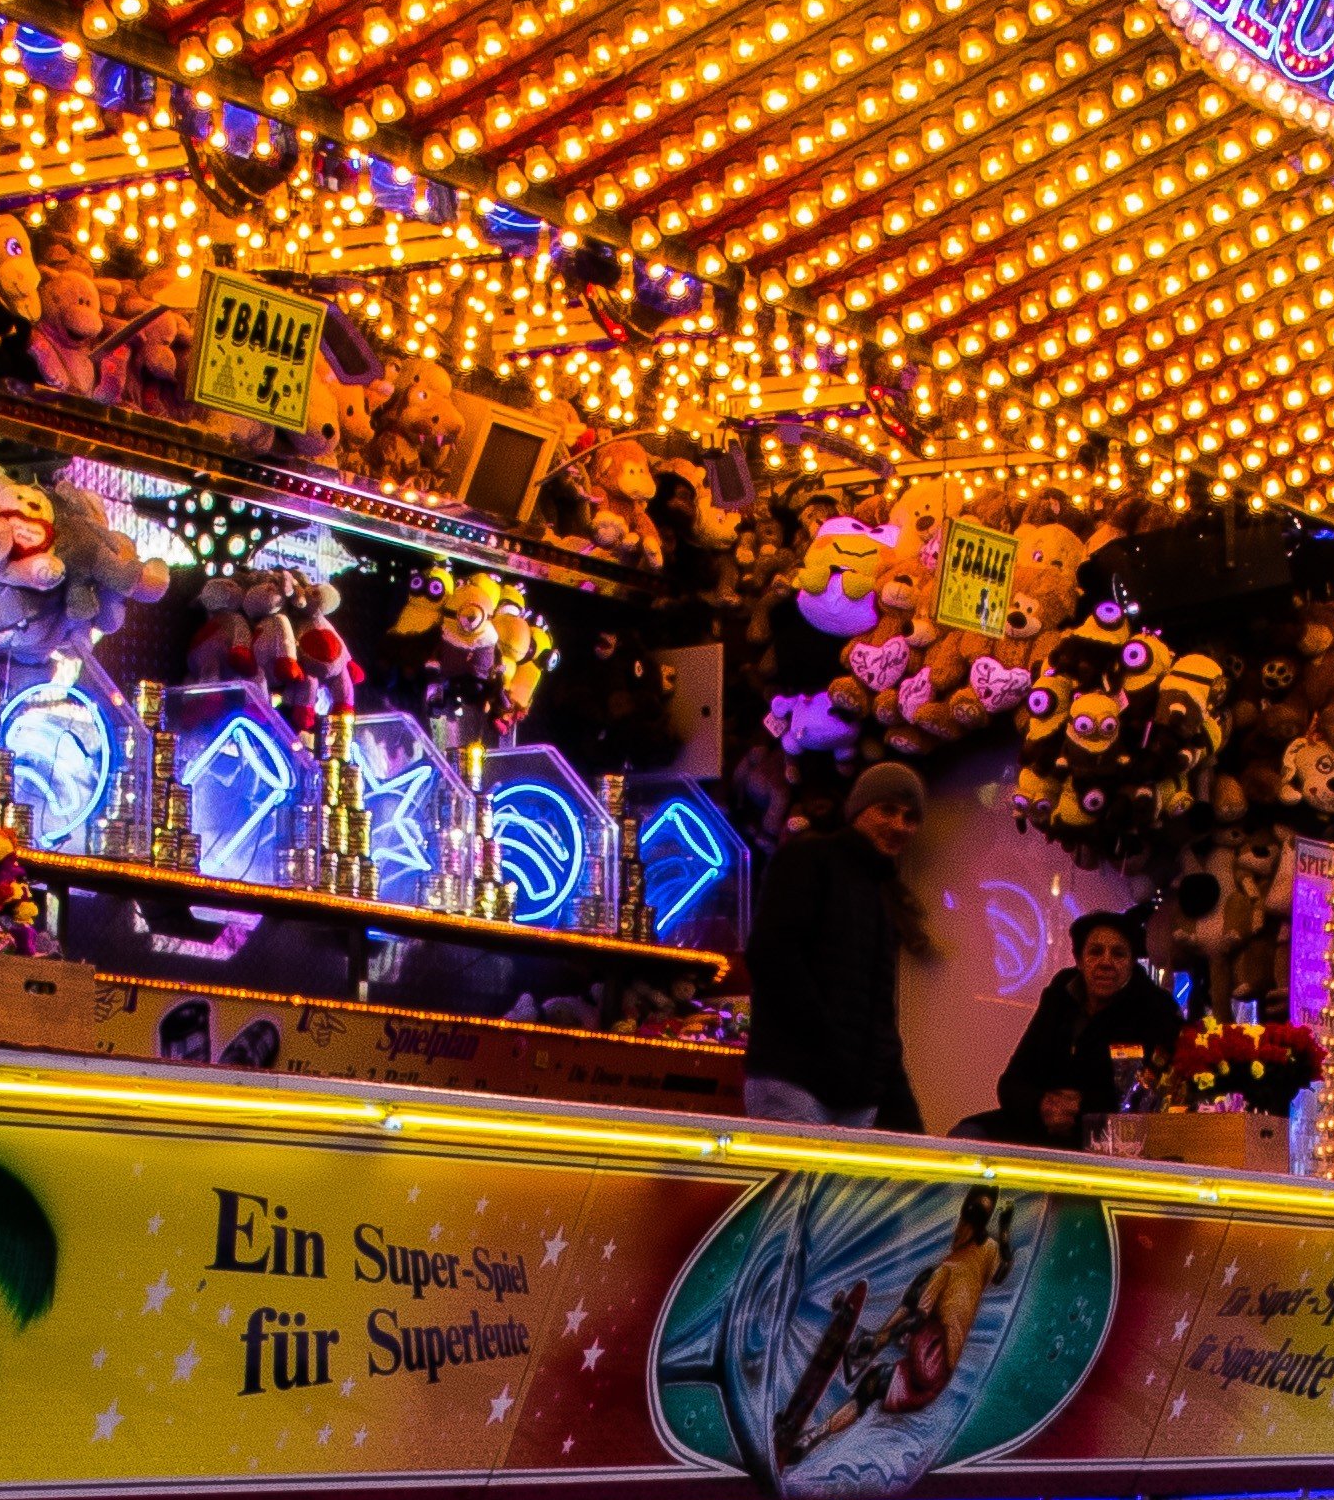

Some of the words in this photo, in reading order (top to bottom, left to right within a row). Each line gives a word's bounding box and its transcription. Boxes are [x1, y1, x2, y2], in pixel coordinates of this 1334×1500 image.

[375, 1015, 481, 1066] Spielplan
[205, 1184, 328, 1282] Ein
[353, 1221, 530, 1300] Super-Spiel
[235, 1305, 340, 1397] für
[367, 1306, 531, 1386] Superleute
